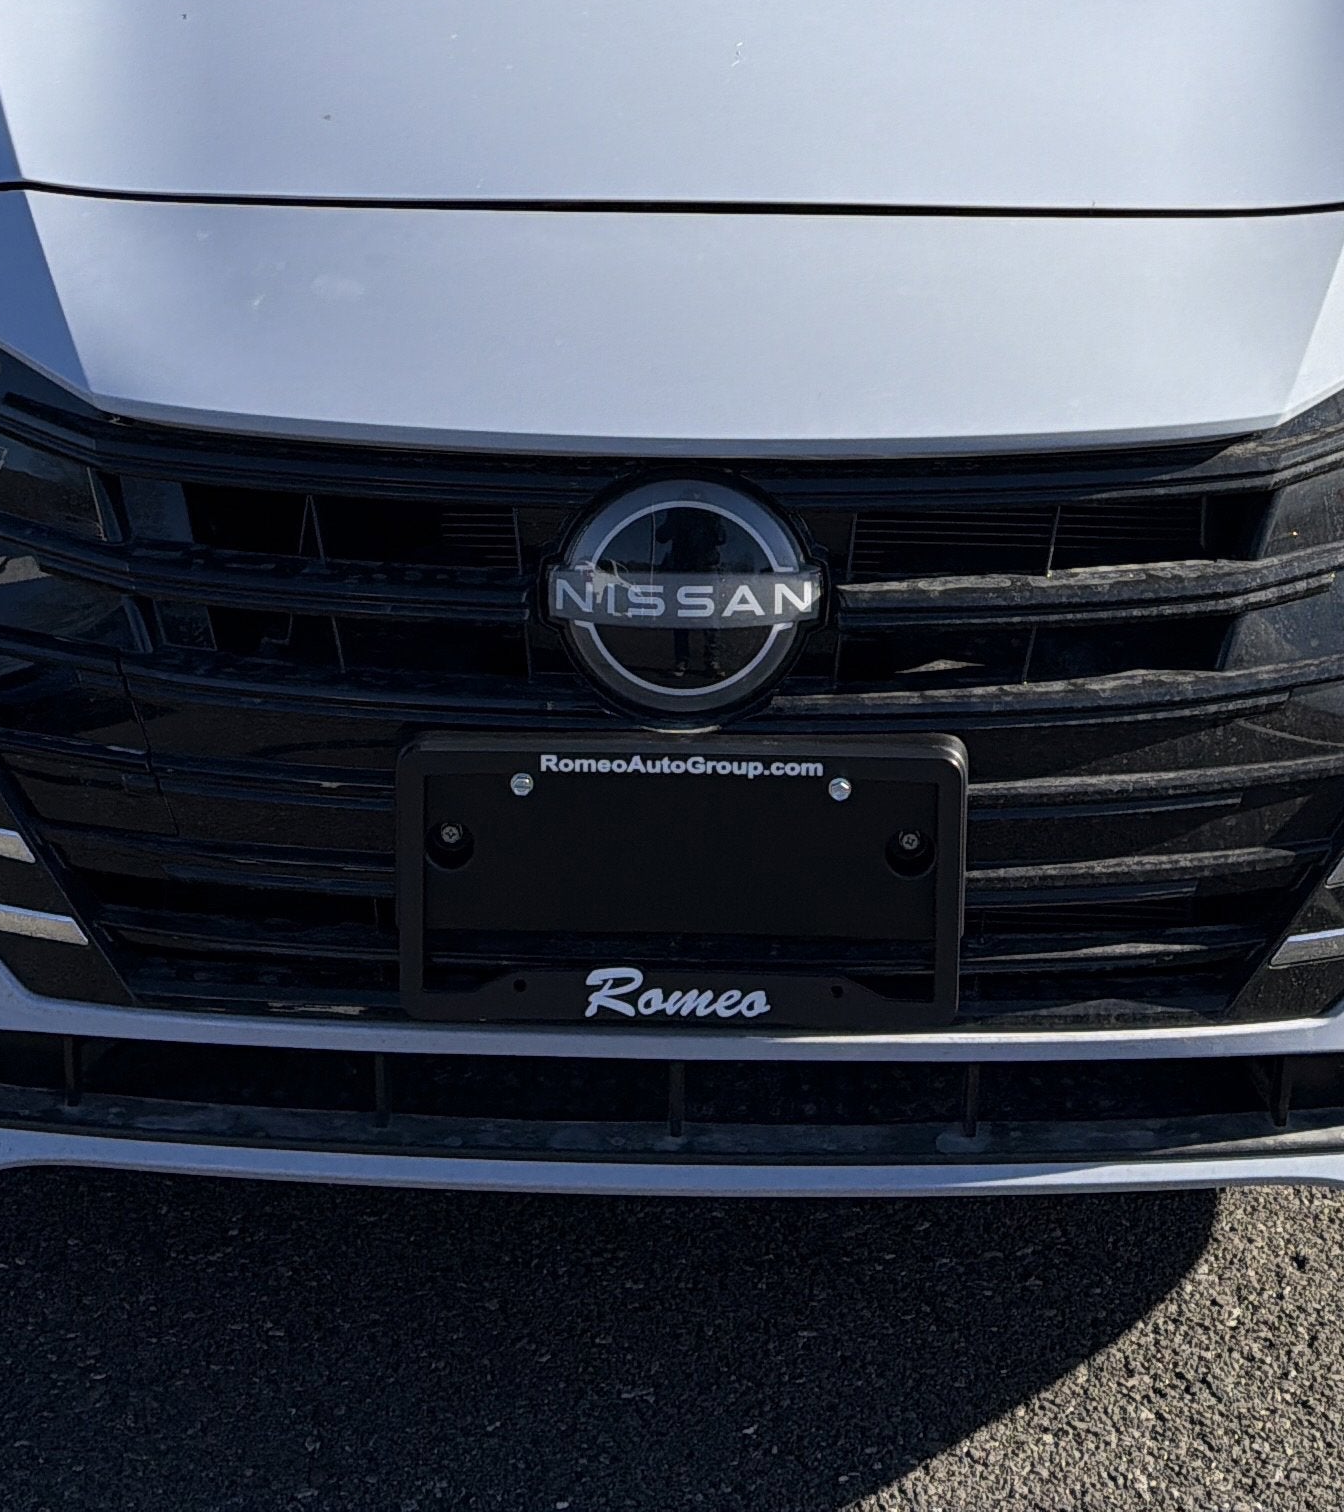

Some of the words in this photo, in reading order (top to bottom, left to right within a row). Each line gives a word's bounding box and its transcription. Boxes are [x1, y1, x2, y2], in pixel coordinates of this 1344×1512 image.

[556, 579, 812, 617] NISSAN
[540, 754, 824, 779] RomeoAutoGroup.com
[585, 967, 771, 1018] Romeo
